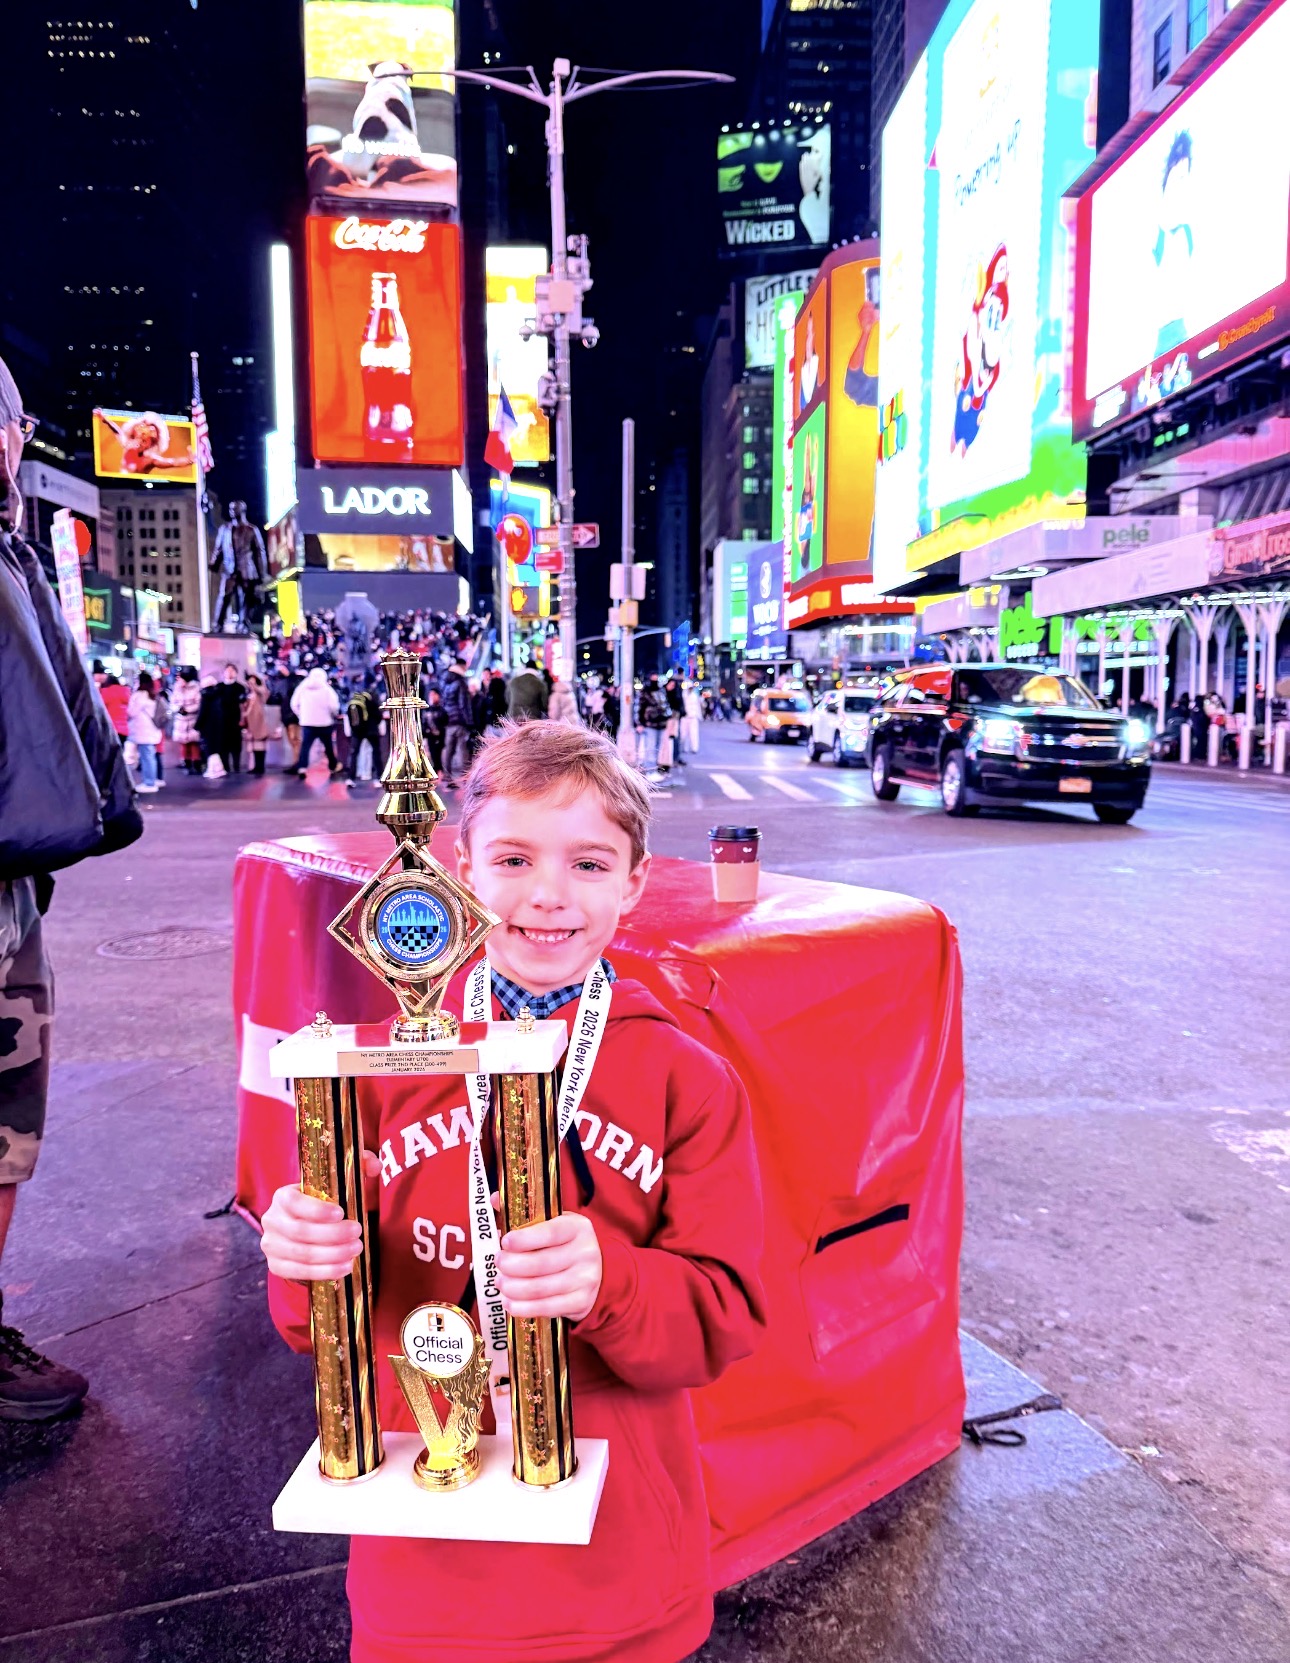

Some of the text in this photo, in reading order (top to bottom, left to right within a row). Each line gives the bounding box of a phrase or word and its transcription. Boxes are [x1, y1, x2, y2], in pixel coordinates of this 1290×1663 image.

[320, 486, 432, 516] LADOR
[385, 897, 401, 914] METRO
[400, 893, 418, 901] AREA
[418, 894, 445, 923] SCHOLASTIC
[386, 938, 443, 960] CHESS CHAMPIONSHIPS
[471, 973, 485, 1008] Chess
[582, 1009, 600, 1038] 2026
[574, 1038, 593, 1066] New
[476, 1074, 487, 1103] Area
[566, 1067, 586, 1094] York
[559, 1094, 576, 1132] Metro
[474, 1177, 486, 1205] New
[476, 1208, 492, 1240] 2026
[484, 1253, 501, 1298] Chess
[486, 1299, 508, 1351] Official
[413, 1335, 463, 1350] Official
[415, 1350, 463, 1364] Chess
